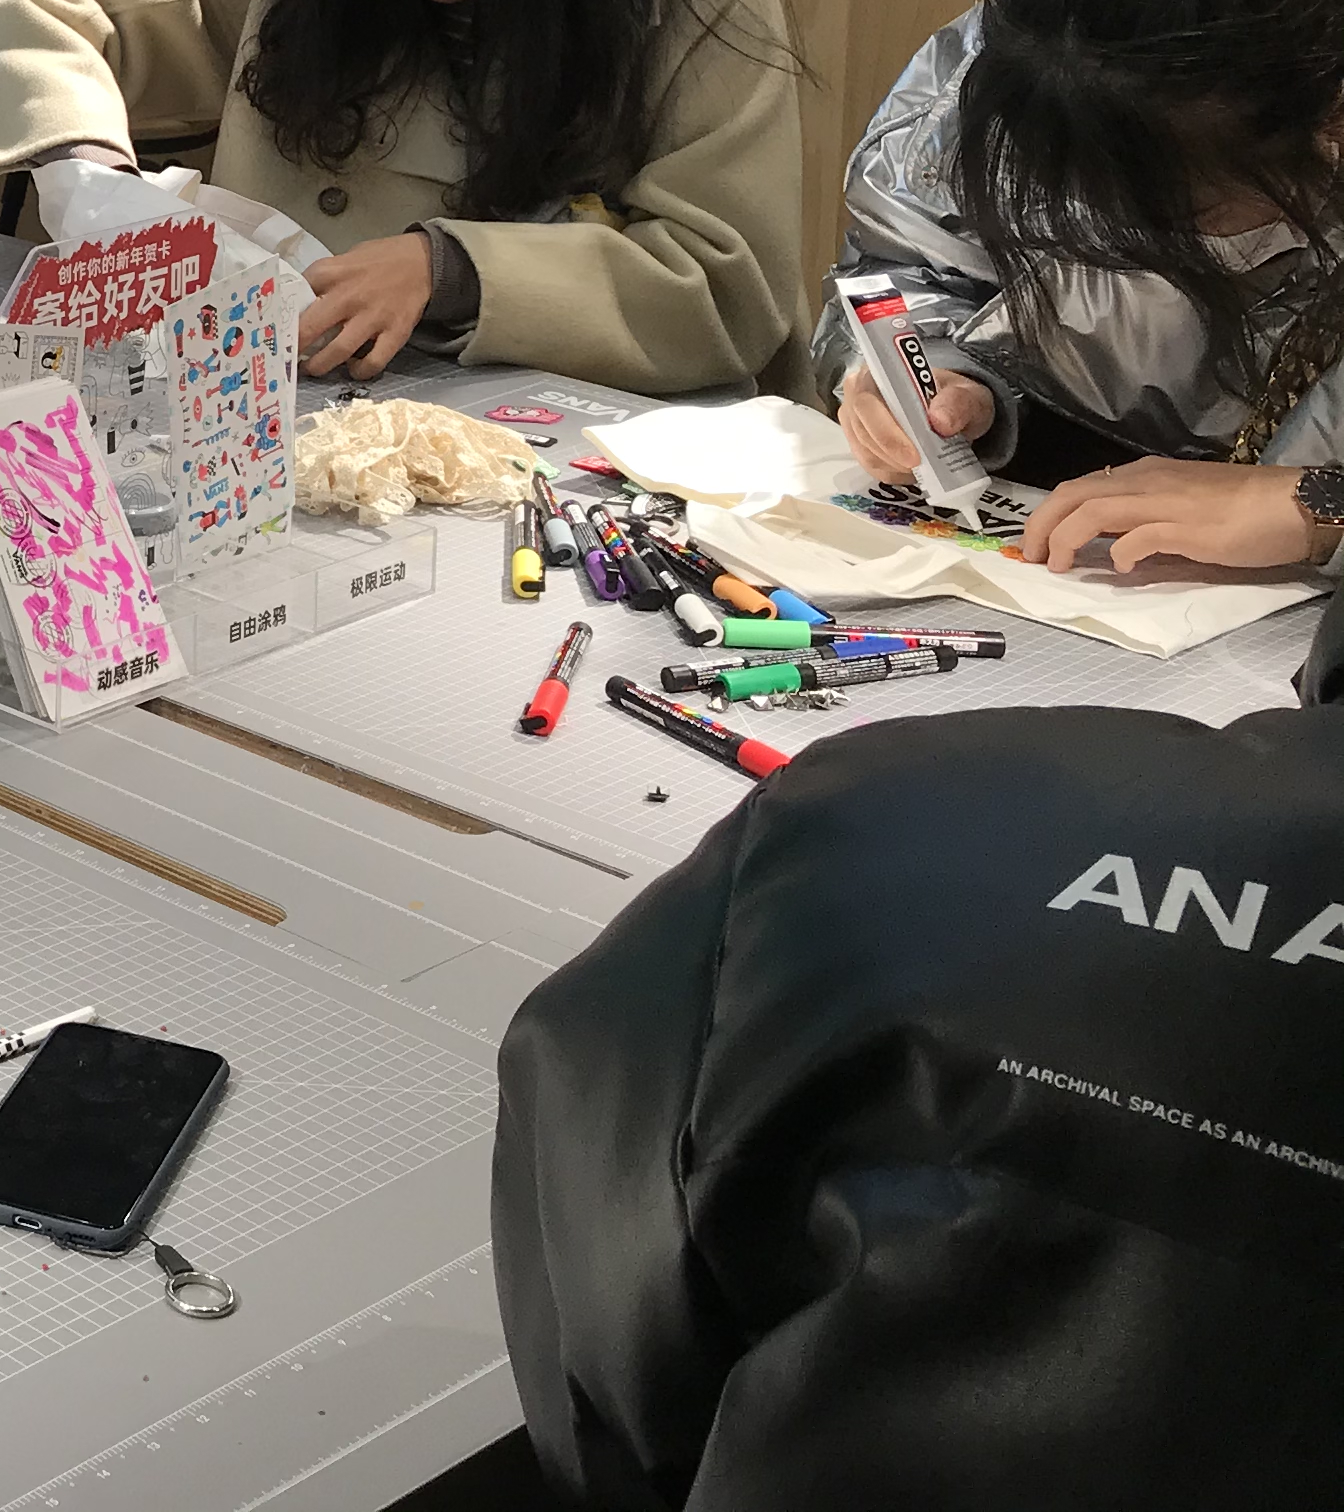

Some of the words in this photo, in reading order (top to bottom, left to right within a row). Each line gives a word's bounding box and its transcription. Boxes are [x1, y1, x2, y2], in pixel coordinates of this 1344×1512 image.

[58, 240, 172, 284] 创作你的新年贺卡
[33, 254, 202, 330] 寄给好友吧
[252, 352, 267, 402] VANS
[203, 476, 231, 501] VANS
[349, 560, 407, 598] 极限运动
[228, 604, 288, 644] 自由涂鸦
[96, 649, 161, 692] 动感音乐
[996, 1057, 1024, 1077] AN
[1025, 1063, 1122, 1108] ARCHIVAL
[1128, 1096, 1195, 1131] SPACE
[1198, 1118, 1227, 1142] AS
[1231, 1129, 1261, 1153] AN
[1264, 1139, 1344, 1181] ARCHIV
